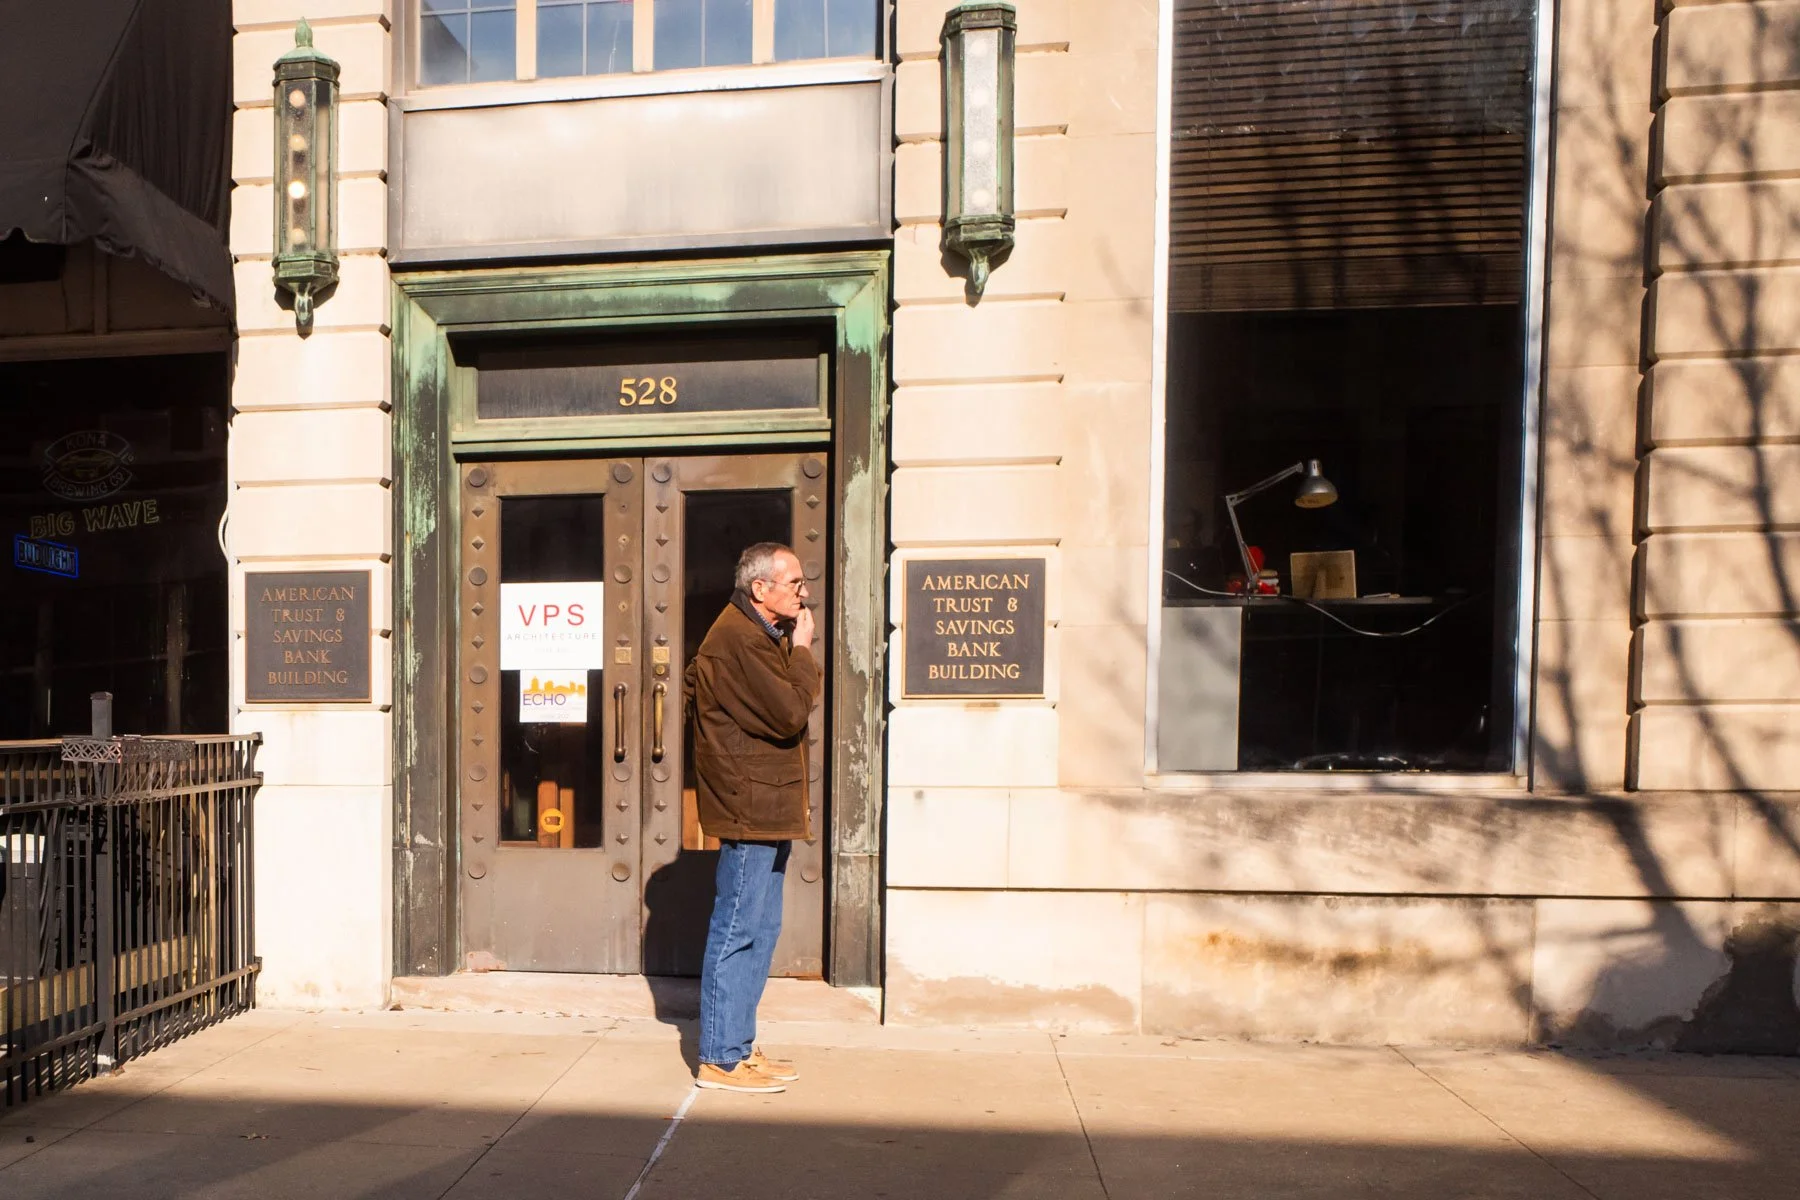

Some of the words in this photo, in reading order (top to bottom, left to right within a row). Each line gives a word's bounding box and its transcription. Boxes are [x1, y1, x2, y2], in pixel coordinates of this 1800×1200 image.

[619, 376, 678, 407] 528
[65, 433, 107, 450] KONA
[51, 477, 108, 497] BREWING
[30, 512, 75, 540] BIG
[82, 499, 160, 533] WAVE
[921, 573, 1030, 591] AMERICAN
[260, 586, 356, 602] AMERICAN
[932, 597, 994, 613] TRUST
[1007, 597, 1018, 613] &
[271, 608, 324, 623] TRUST
[335, 607, 345, 622] &
[518, 603, 585, 627] VPS
[935, 619, 1015, 635] SAVINGS
[272, 629, 344, 643] SAVINGS
[506, 632, 598, 641] ARCHITECTURE
[284, 649, 332, 664] BANK
[947, 641, 1001, 657] BANK
[267, 670, 348, 685] BUILDING
[928, 663, 1021, 680] BUILDING
[522, 693, 567, 706] ECHO
